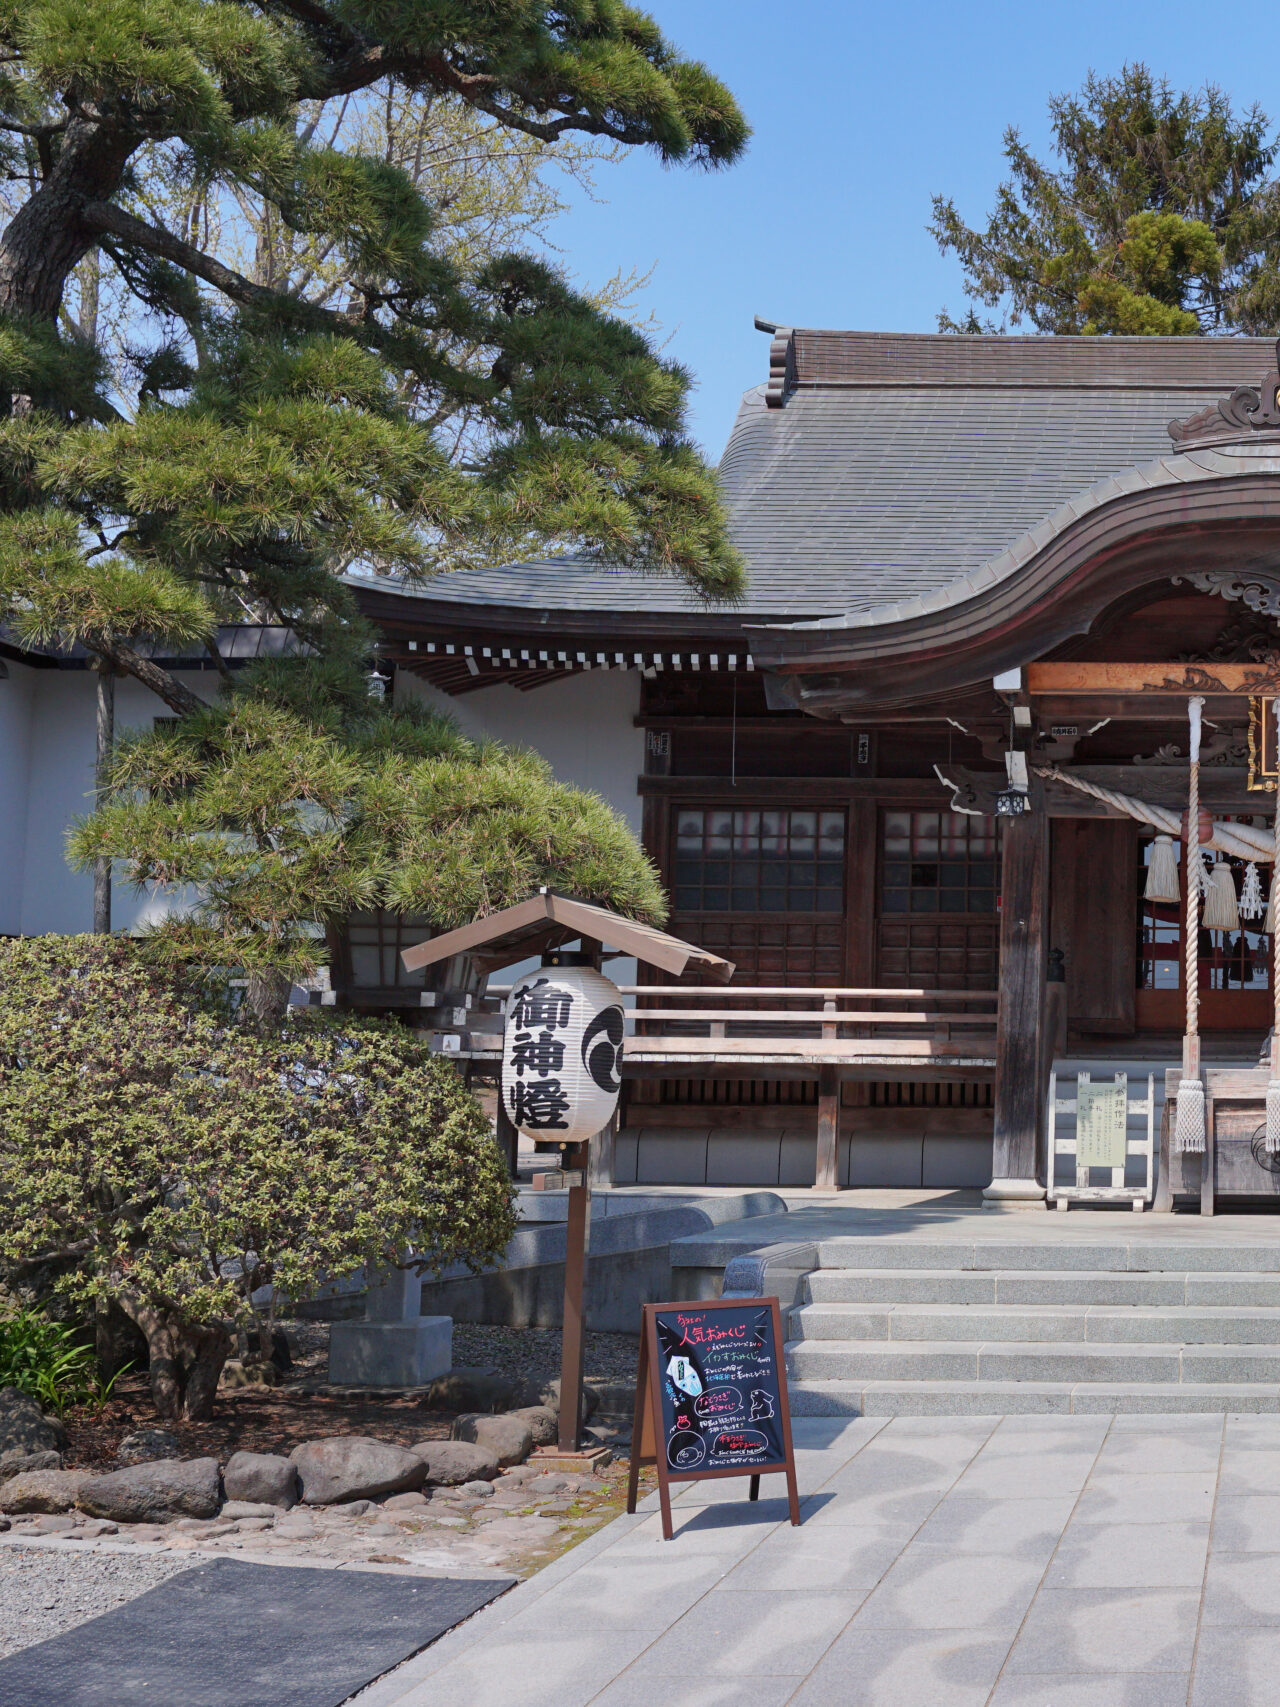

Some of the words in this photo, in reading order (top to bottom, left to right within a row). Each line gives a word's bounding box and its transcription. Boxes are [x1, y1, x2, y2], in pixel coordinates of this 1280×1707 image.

[510, 978, 574, 1129] 御神燈
[1113, 1088, 1125, 1129] 参拝作法
[680, 1325, 746, 1346] 人気おみくじ
